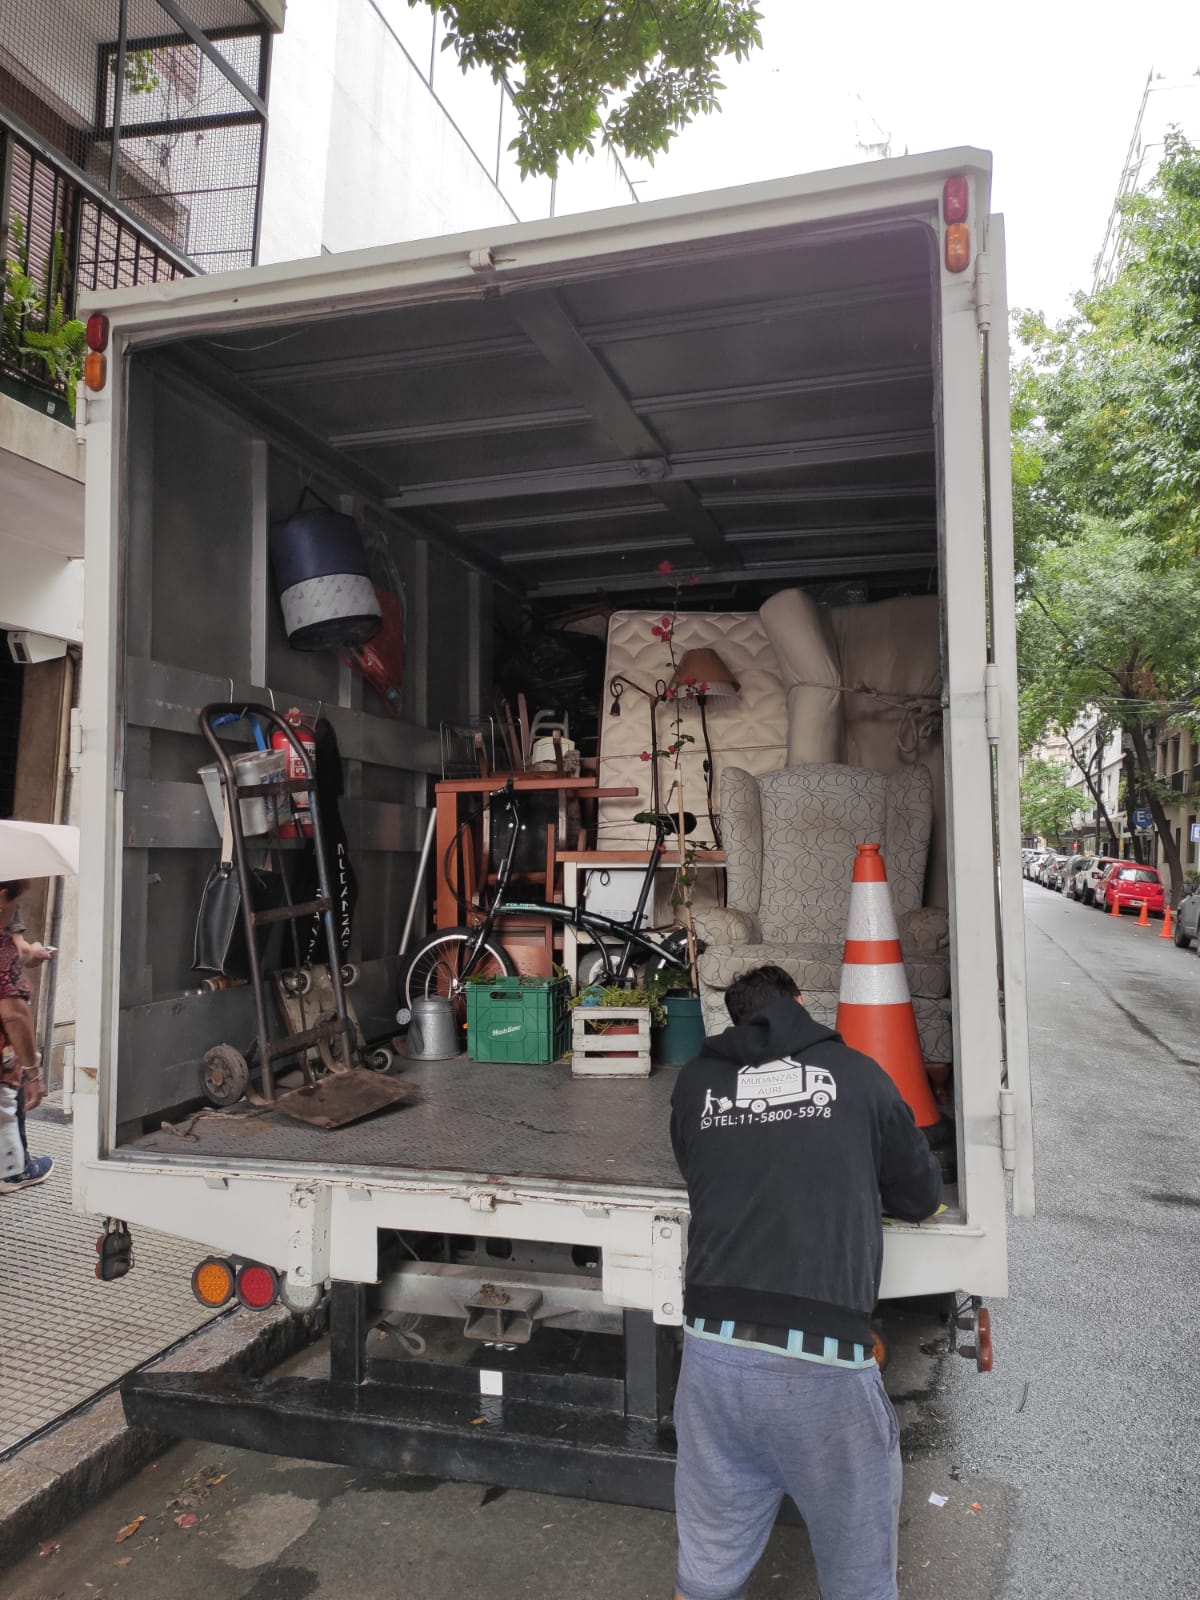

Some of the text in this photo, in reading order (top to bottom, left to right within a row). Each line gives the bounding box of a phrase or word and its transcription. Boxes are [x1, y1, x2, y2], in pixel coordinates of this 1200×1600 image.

[1136, 810, 1147, 823] E
[741, 1073, 799, 1085] MUDANZAS
[758, 1086, 782, 1095] AURI
[713, 1106, 832, 1127] TEL:11-5800-5978
